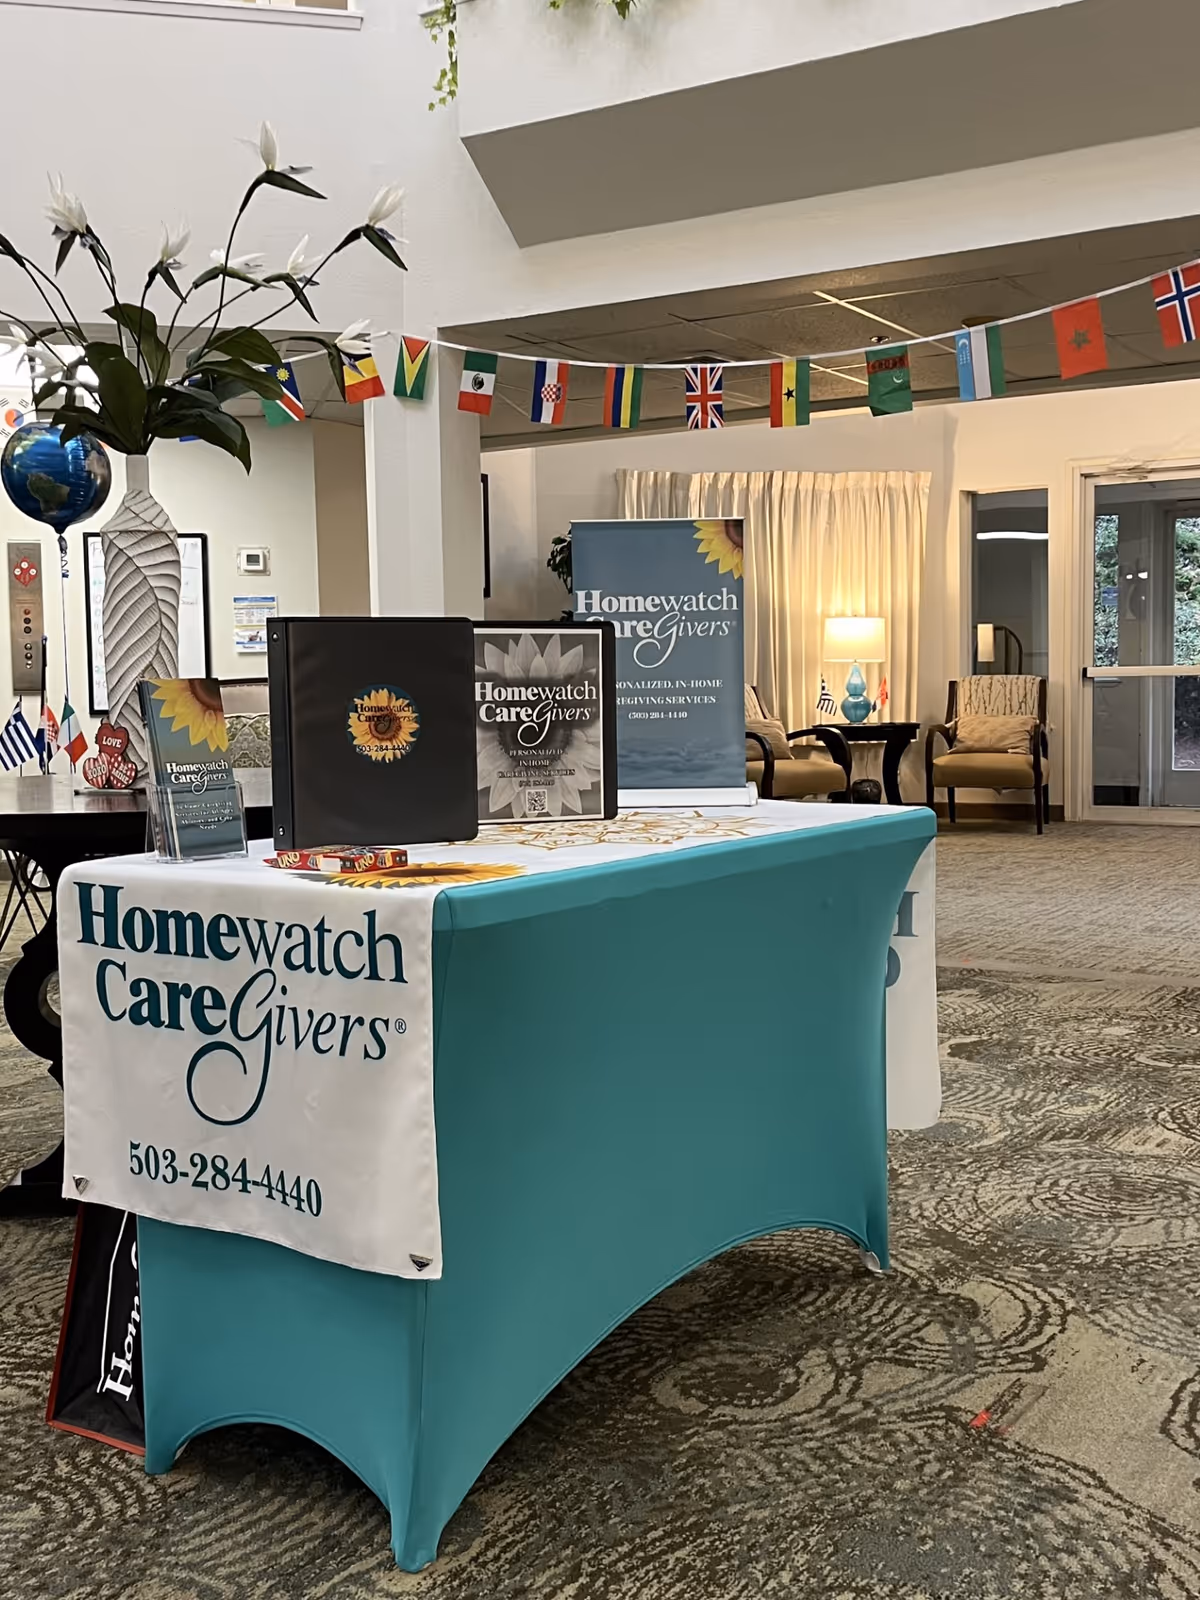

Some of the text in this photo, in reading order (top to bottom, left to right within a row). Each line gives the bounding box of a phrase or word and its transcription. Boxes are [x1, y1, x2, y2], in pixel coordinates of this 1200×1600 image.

[575, 587, 739, 614] Homewatch
[474, 680, 598, 702] Homewatch
[675, 679, 723, 688] IN-HOME
[355, 703, 414, 713] Homewatch
[665, 695, 717, 705] SERVICES
[479, 699, 592, 747] CareGivers
[628, 711, 688, 720] (503) 284-4440
[102, 735, 122, 748] LOVE
[356, 744, 411, 753] 503-284-4440
[510, 748, 563, 757] PERSONALIZED
[87, 764, 107, 780] XOXO
[165, 759, 229, 774] Homewatch
[111, 768, 130, 785] MINE
[171, 770, 227, 795] CareGivers
[278, 851, 301, 868] UNO
[354, 853, 375, 873] UNO
[73, 881, 409, 984] Homewatch
[129, 1139, 323, 1218] 503-284-4440
